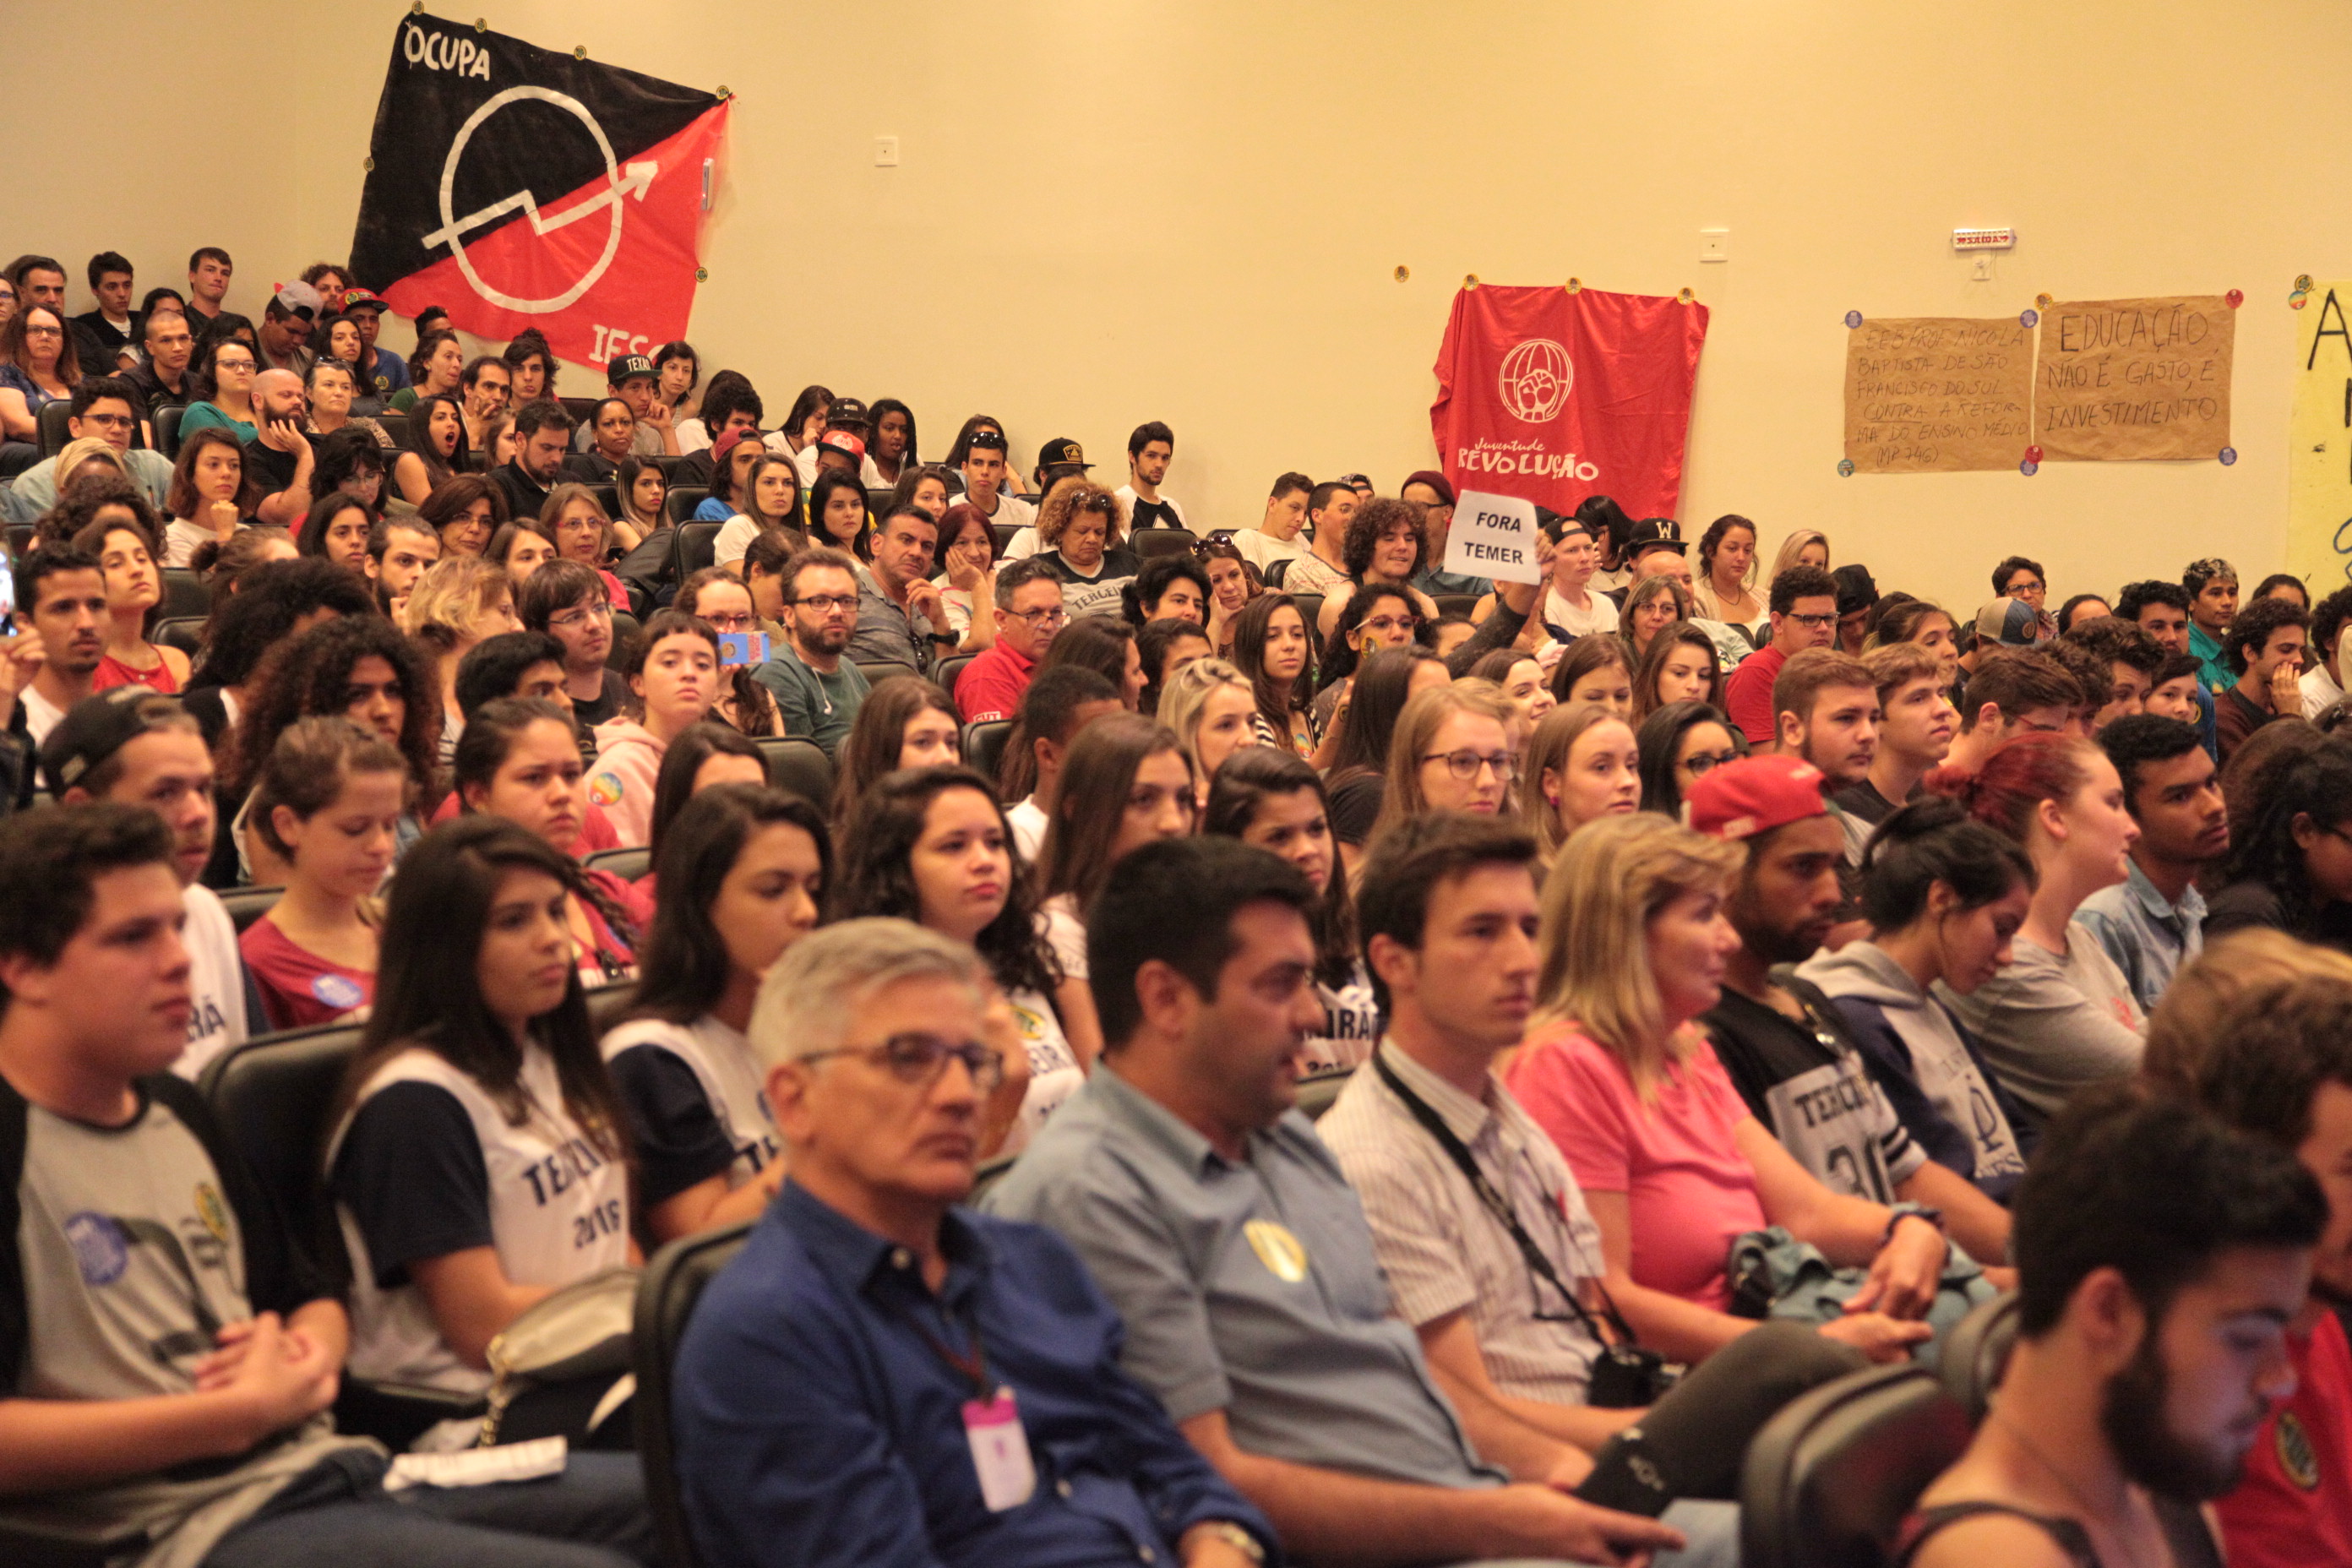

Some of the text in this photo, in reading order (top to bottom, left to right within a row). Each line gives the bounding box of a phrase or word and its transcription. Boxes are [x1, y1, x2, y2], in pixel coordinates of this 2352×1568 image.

[404, 25, 490, 81] OCUPA
[1954, 326, 2025, 348] NICOLA
[2060, 303, 2208, 353] EDUCAÇÃO
[1858, 351, 2008, 377] BAPTISTA DE SÃO
[2048, 358, 2088, 389] NÃO
[2096, 355, 2111, 388] É
[1857, 379, 2005, 400] FRANCISCO DO SUL
[1864, 402, 1929, 421] CONTRA
[2044, 397, 2218, 432] INVESTIMENTO
[1857, 417, 2028, 444] MA DO ENSINO MÉDIO
[1474, 437, 1545, 451] Juventude
[1457, 448, 1599, 482] REVOLUÇÃO
[1476, 512, 1522, 532] FORA
[1656, 521, 1672, 539] W
[1464, 542, 1524, 564] TEMER
[1072, 585, 1123, 610] TERCEI
